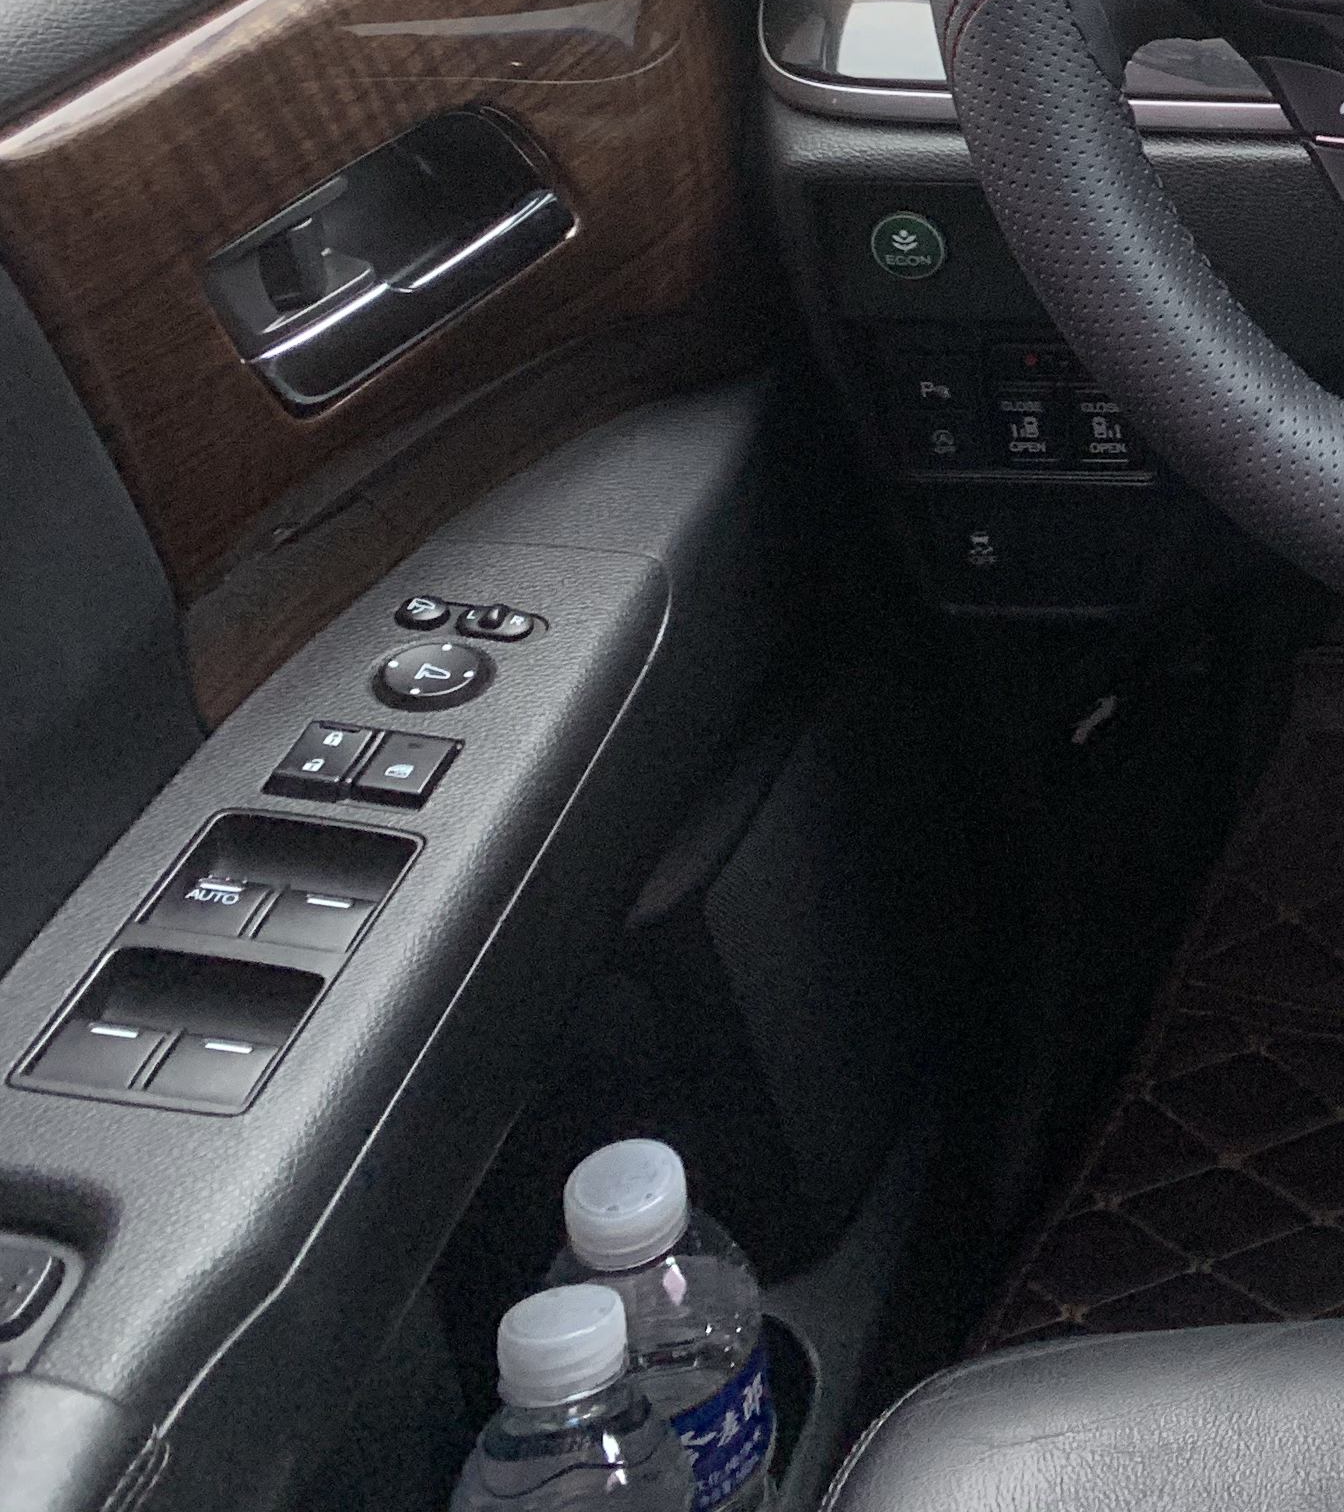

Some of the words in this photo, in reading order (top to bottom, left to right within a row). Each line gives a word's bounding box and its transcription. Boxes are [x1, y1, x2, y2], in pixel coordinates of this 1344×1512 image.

[885, 254, 932, 267] ECON
[466, 609, 476, 620] L
[509, 614, 526, 626] R
[184, 888, 240, 905] AUTO
